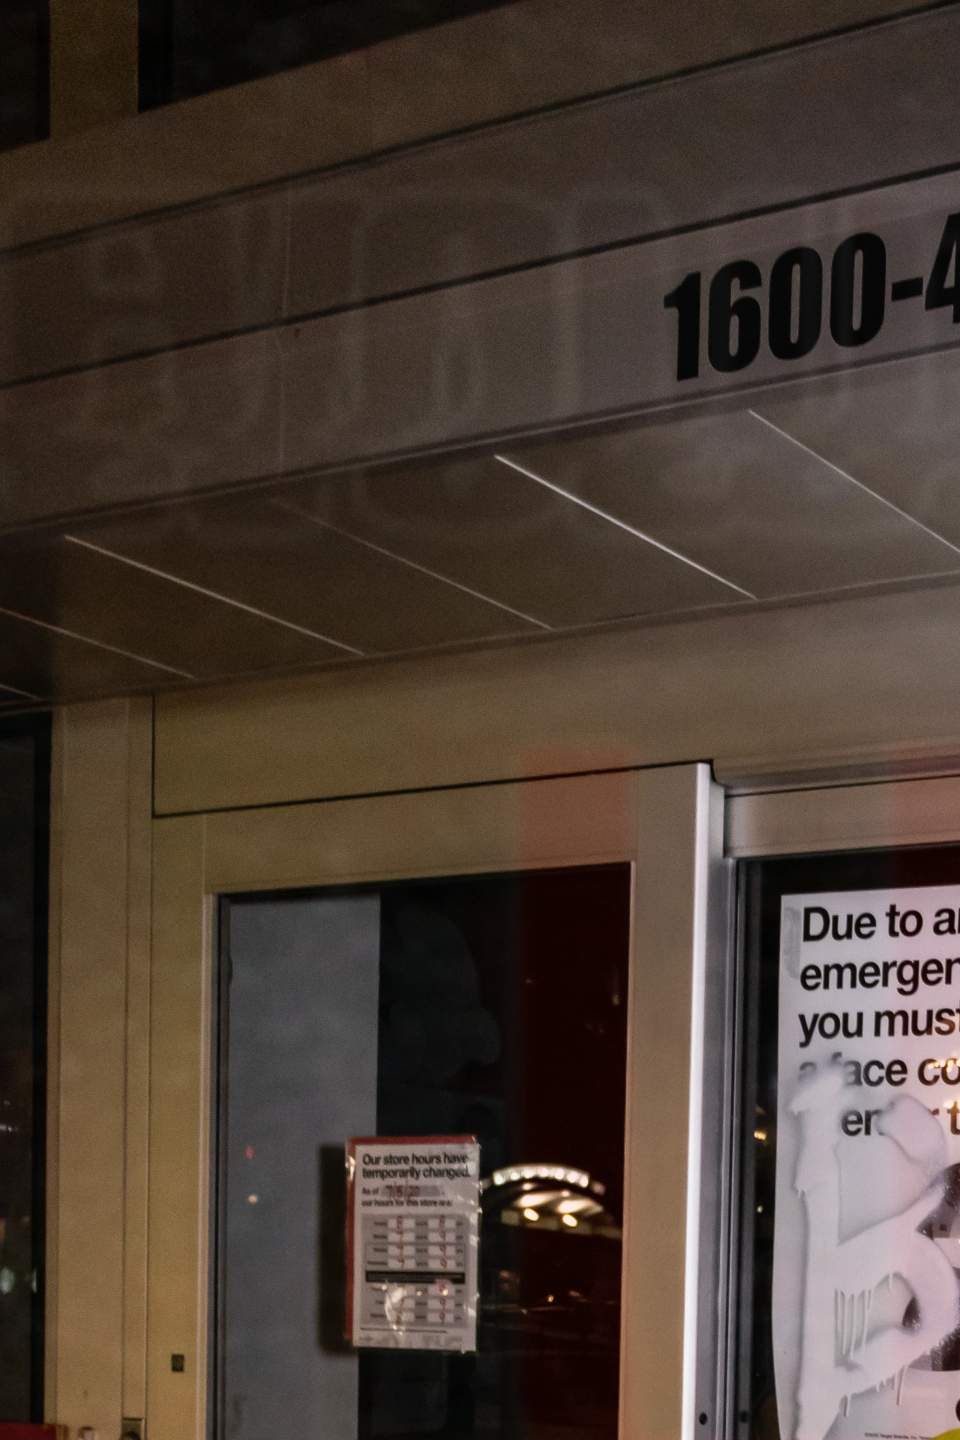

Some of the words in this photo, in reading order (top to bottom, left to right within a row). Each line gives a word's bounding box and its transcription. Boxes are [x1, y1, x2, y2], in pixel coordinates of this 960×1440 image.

[802, 905, 876, 942] Due
[885, 904, 923, 937] to
[798, 1009, 864, 1048] you
[362, 1153, 381, 1165] Our
[383, 1154, 410, 1165] store
[411, 1153, 441, 1165] hours
[443, 1152, 469, 1164] have
[362, 1167, 420, 1180] temporarily
